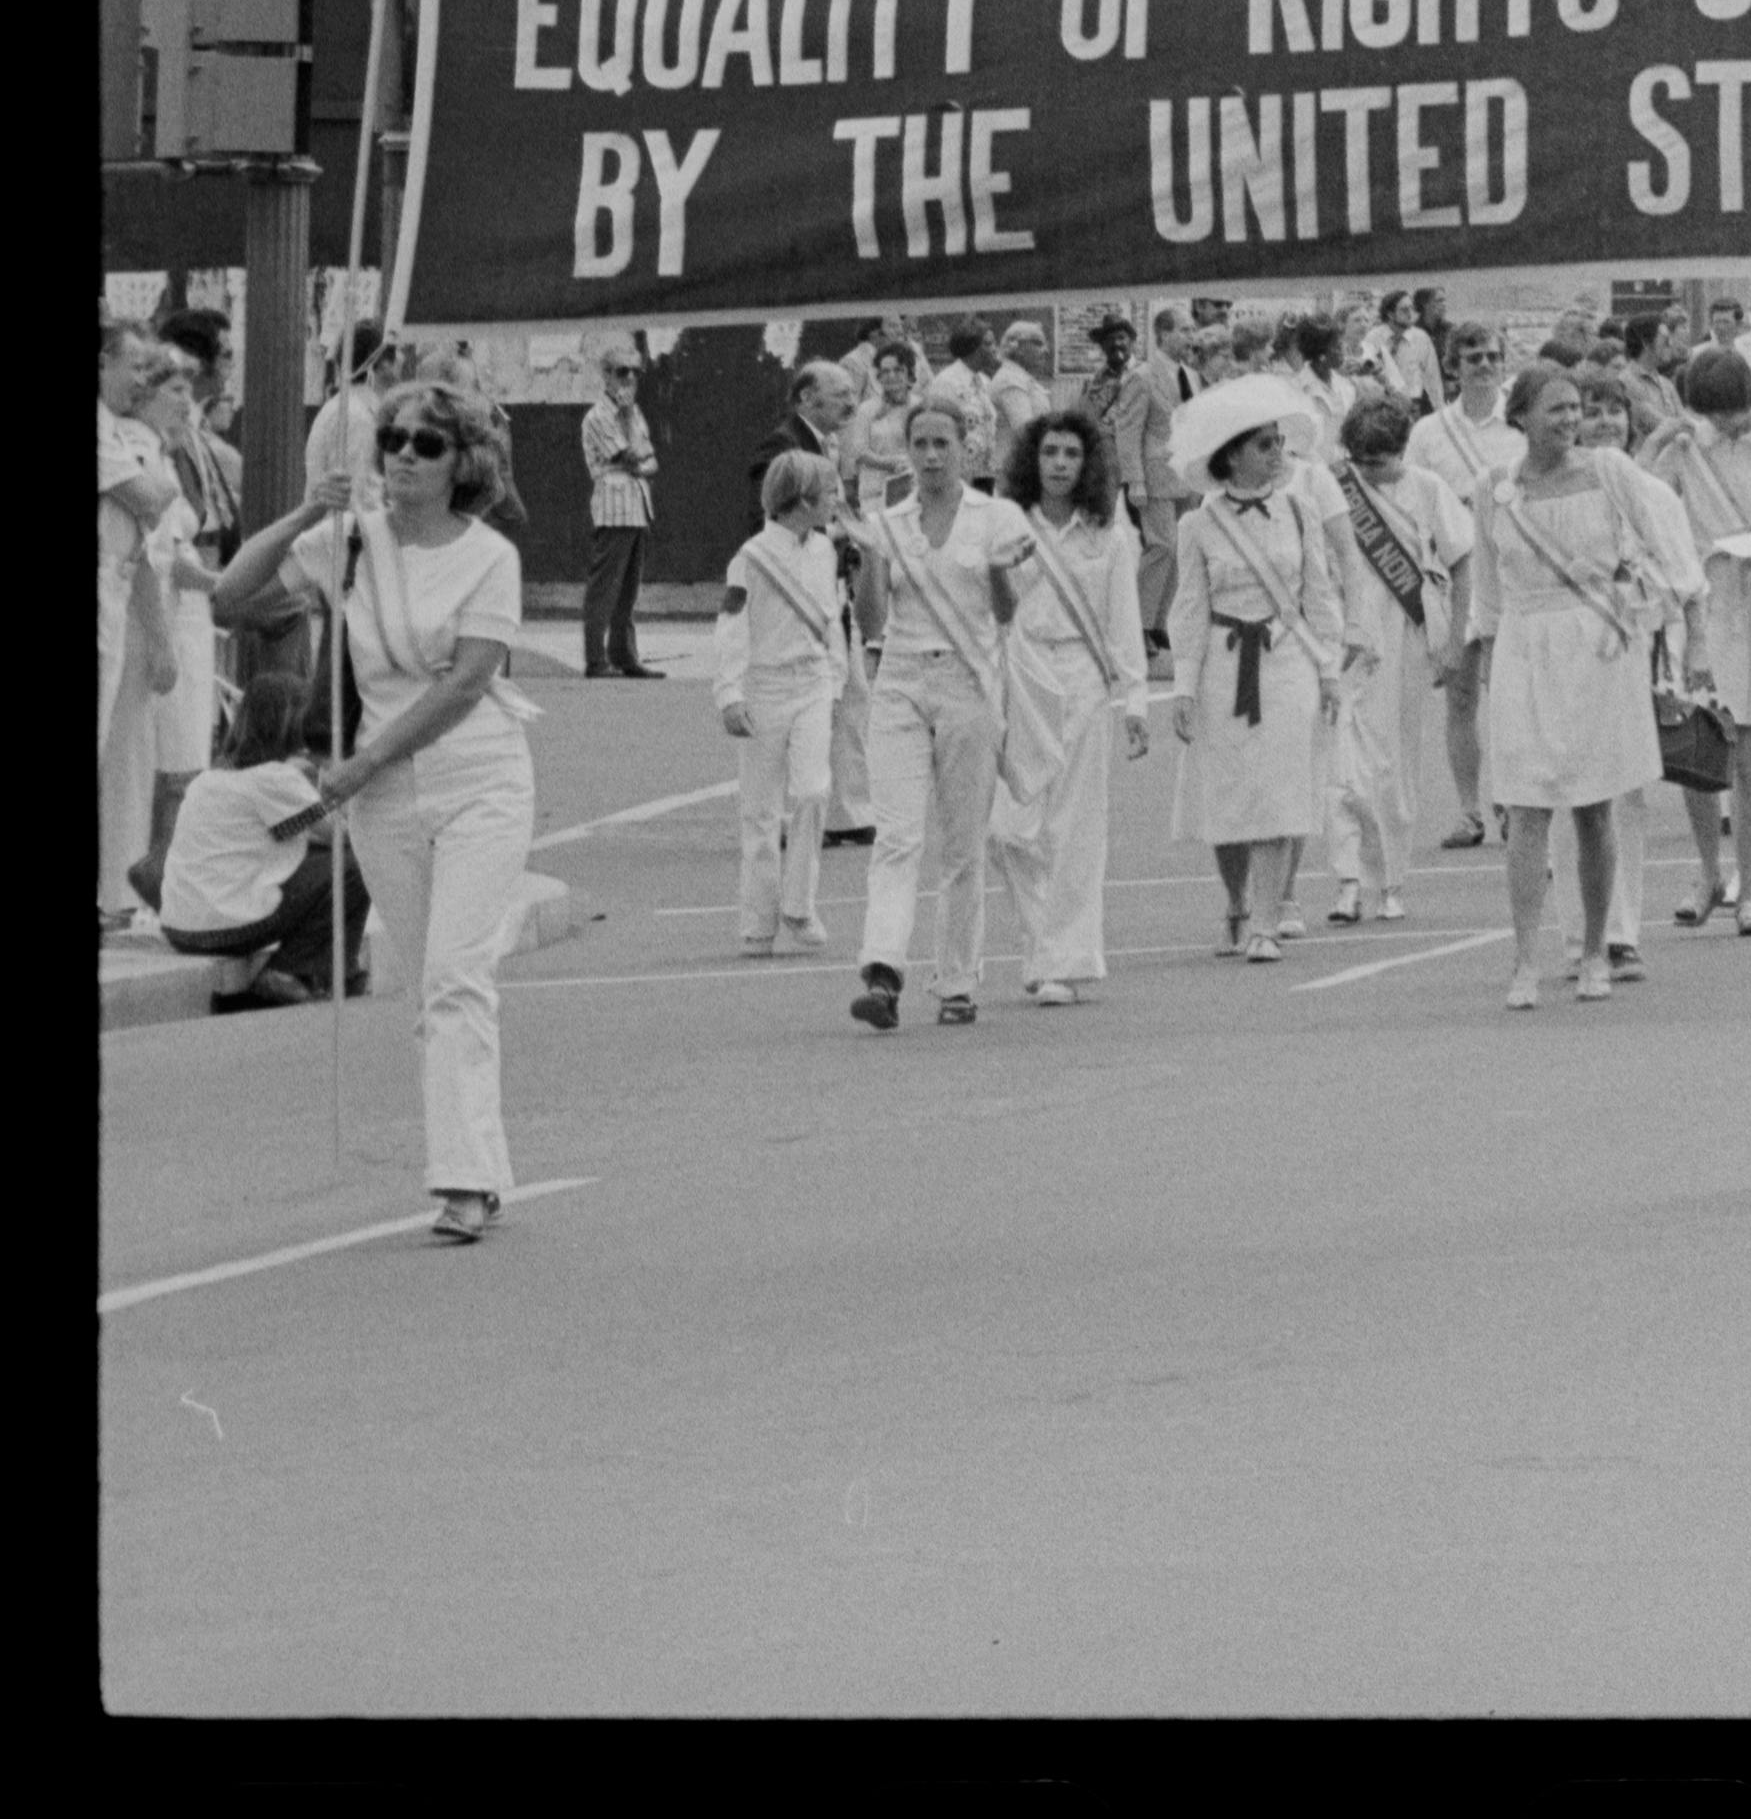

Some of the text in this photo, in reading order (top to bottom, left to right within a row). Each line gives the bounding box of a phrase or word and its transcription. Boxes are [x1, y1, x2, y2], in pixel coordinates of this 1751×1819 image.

[574, 129, 720, 277] BY
[833, 108, 1033, 257] THE
[1149, 78, 1528, 242] UNITED
[1334, 466, 1418, 595] ORIDA NOW
